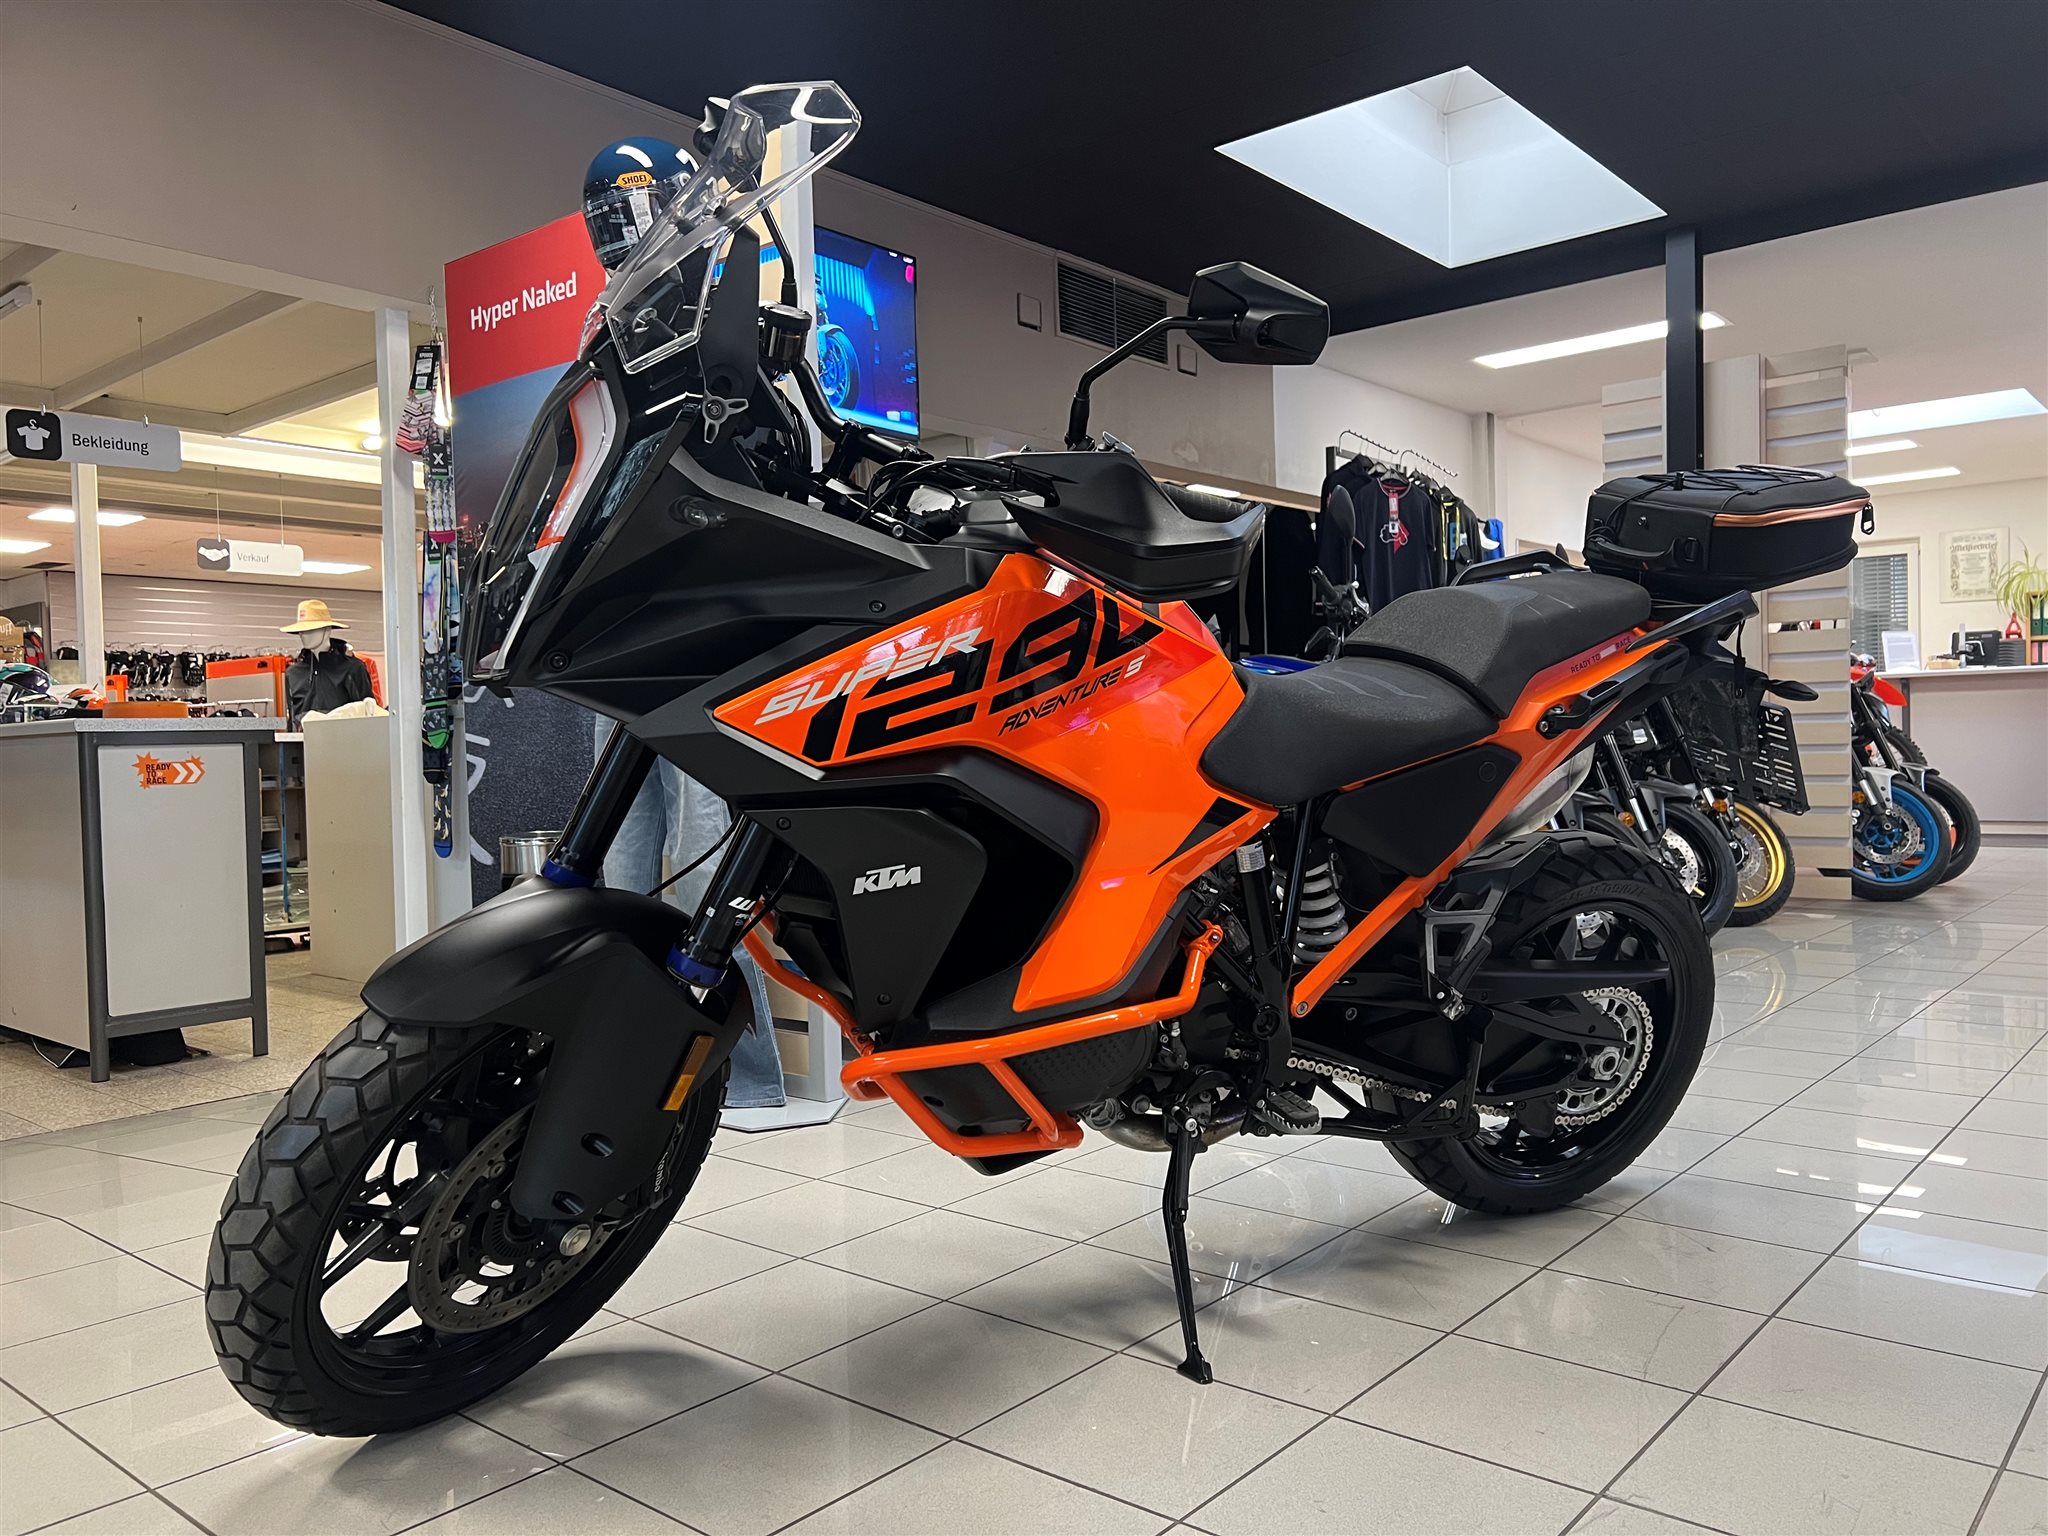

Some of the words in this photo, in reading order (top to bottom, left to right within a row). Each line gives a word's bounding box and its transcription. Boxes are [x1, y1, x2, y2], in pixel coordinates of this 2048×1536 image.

[621, 174, 647, 185] SHOEI
[470, 297, 519, 333] Hyper
[522, 271, 577, 312] Naked
[72, 433, 150, 456] Bekleidung
[432, 452, 445, 465] X
[237, 552, 269, 563] Verkauf
[1571, 658, 1591, 673] READY
[1591, 653, 1601, 663] TO
[1615, 636, 1631, 649] RACE
[754, 626, 984, 726] SUPER
[998, 664, 1124, 736] ADVENTURE
[1123, 654, 1147, 679] S
[146, 763, 171, 771] READY
[147, 770, 157, 778] TO
[147, 777, 167, 785] RACE
[852, 864, 921, 895] KTM
